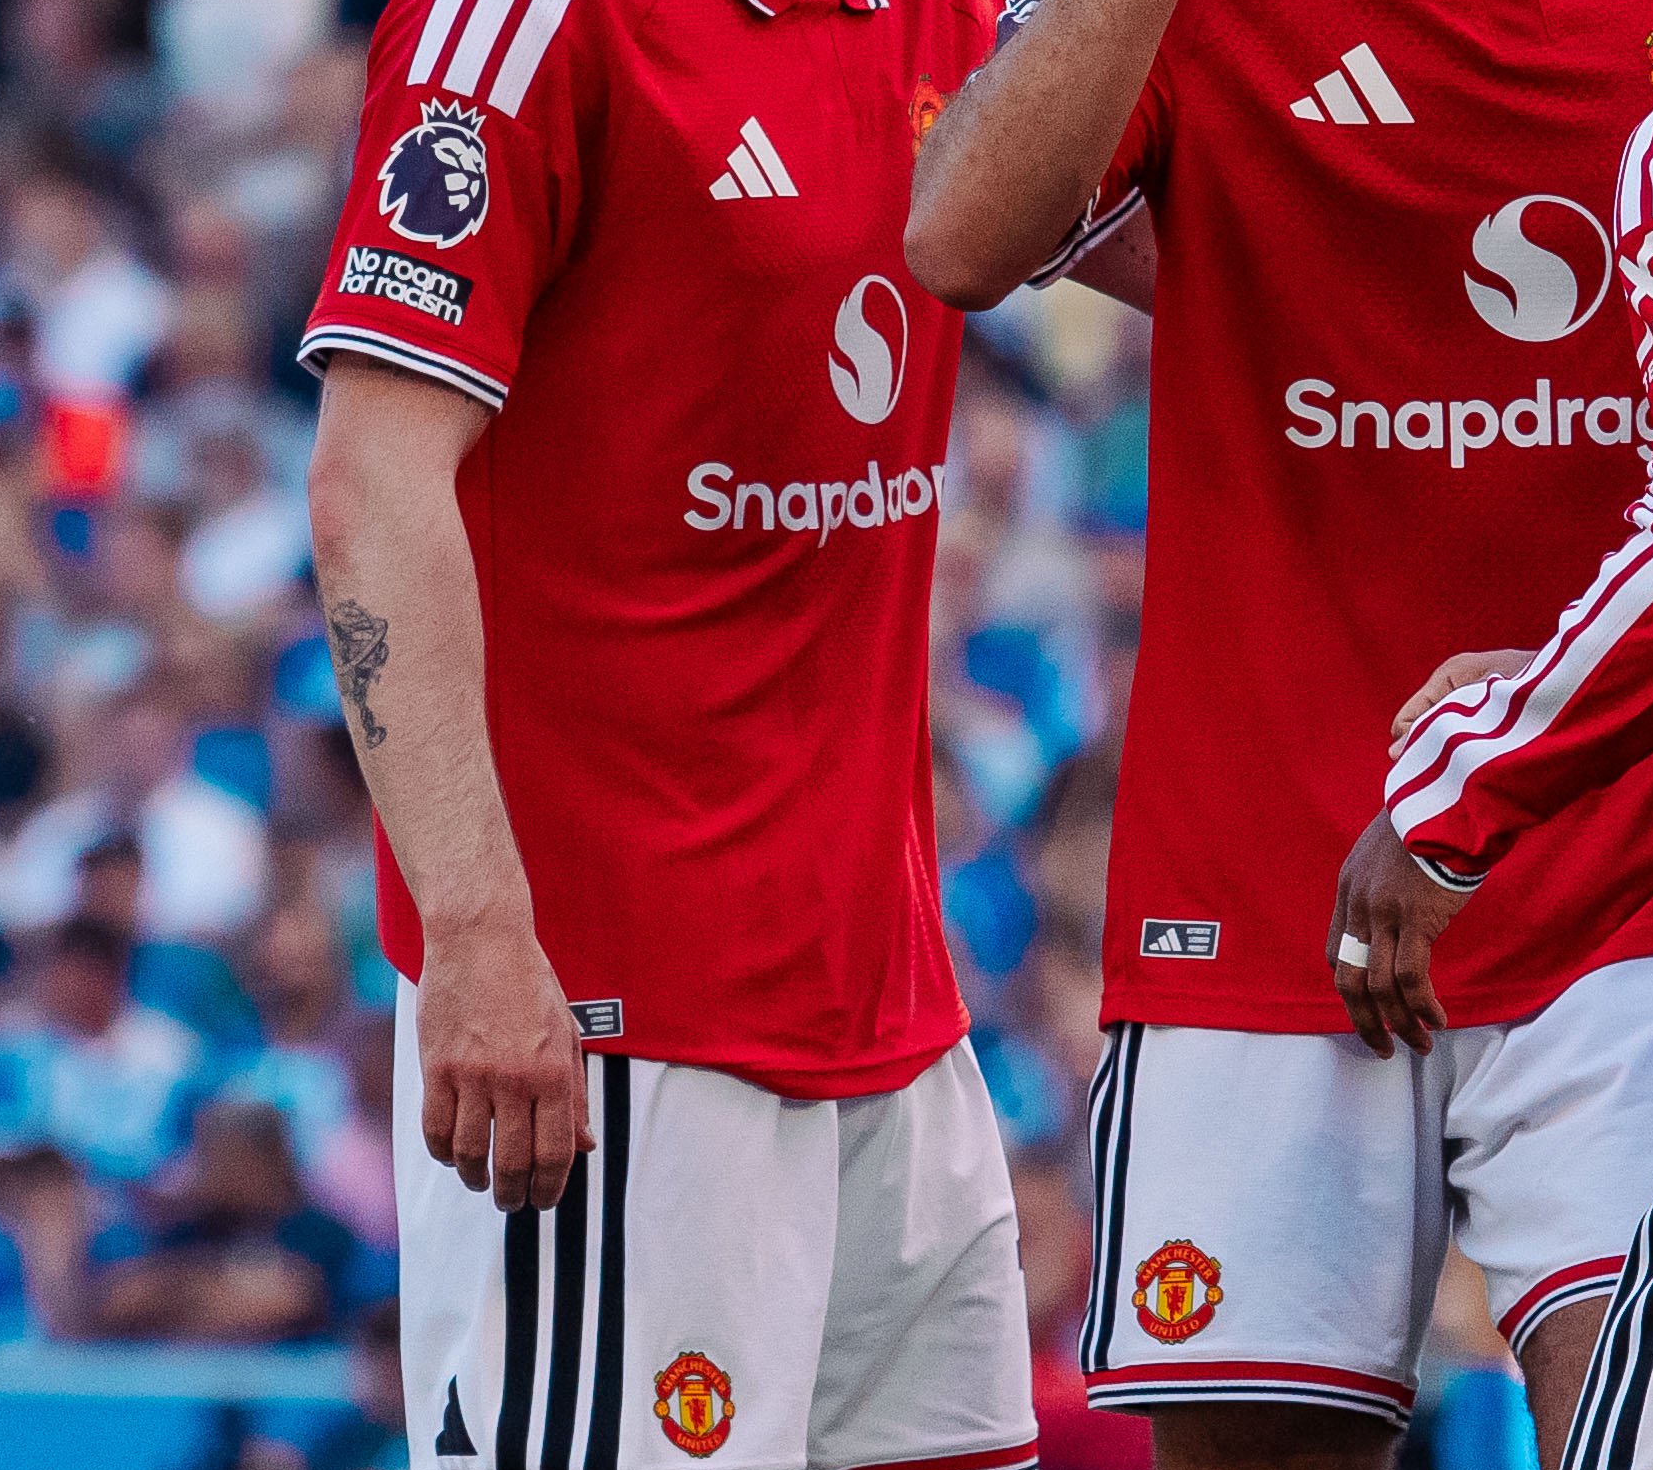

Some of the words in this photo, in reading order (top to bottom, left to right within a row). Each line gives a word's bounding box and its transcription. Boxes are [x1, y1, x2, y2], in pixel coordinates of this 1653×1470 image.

[346, 246, 381, 272] No
[382, 255, 458, 299] room
[337, 269, 375, 294] for
[374, 276, 463, 326] racism
[1141, 1247, 1215, 1282] MANCHESTER
[1149, 1319, 1200, 1338] UNITED
